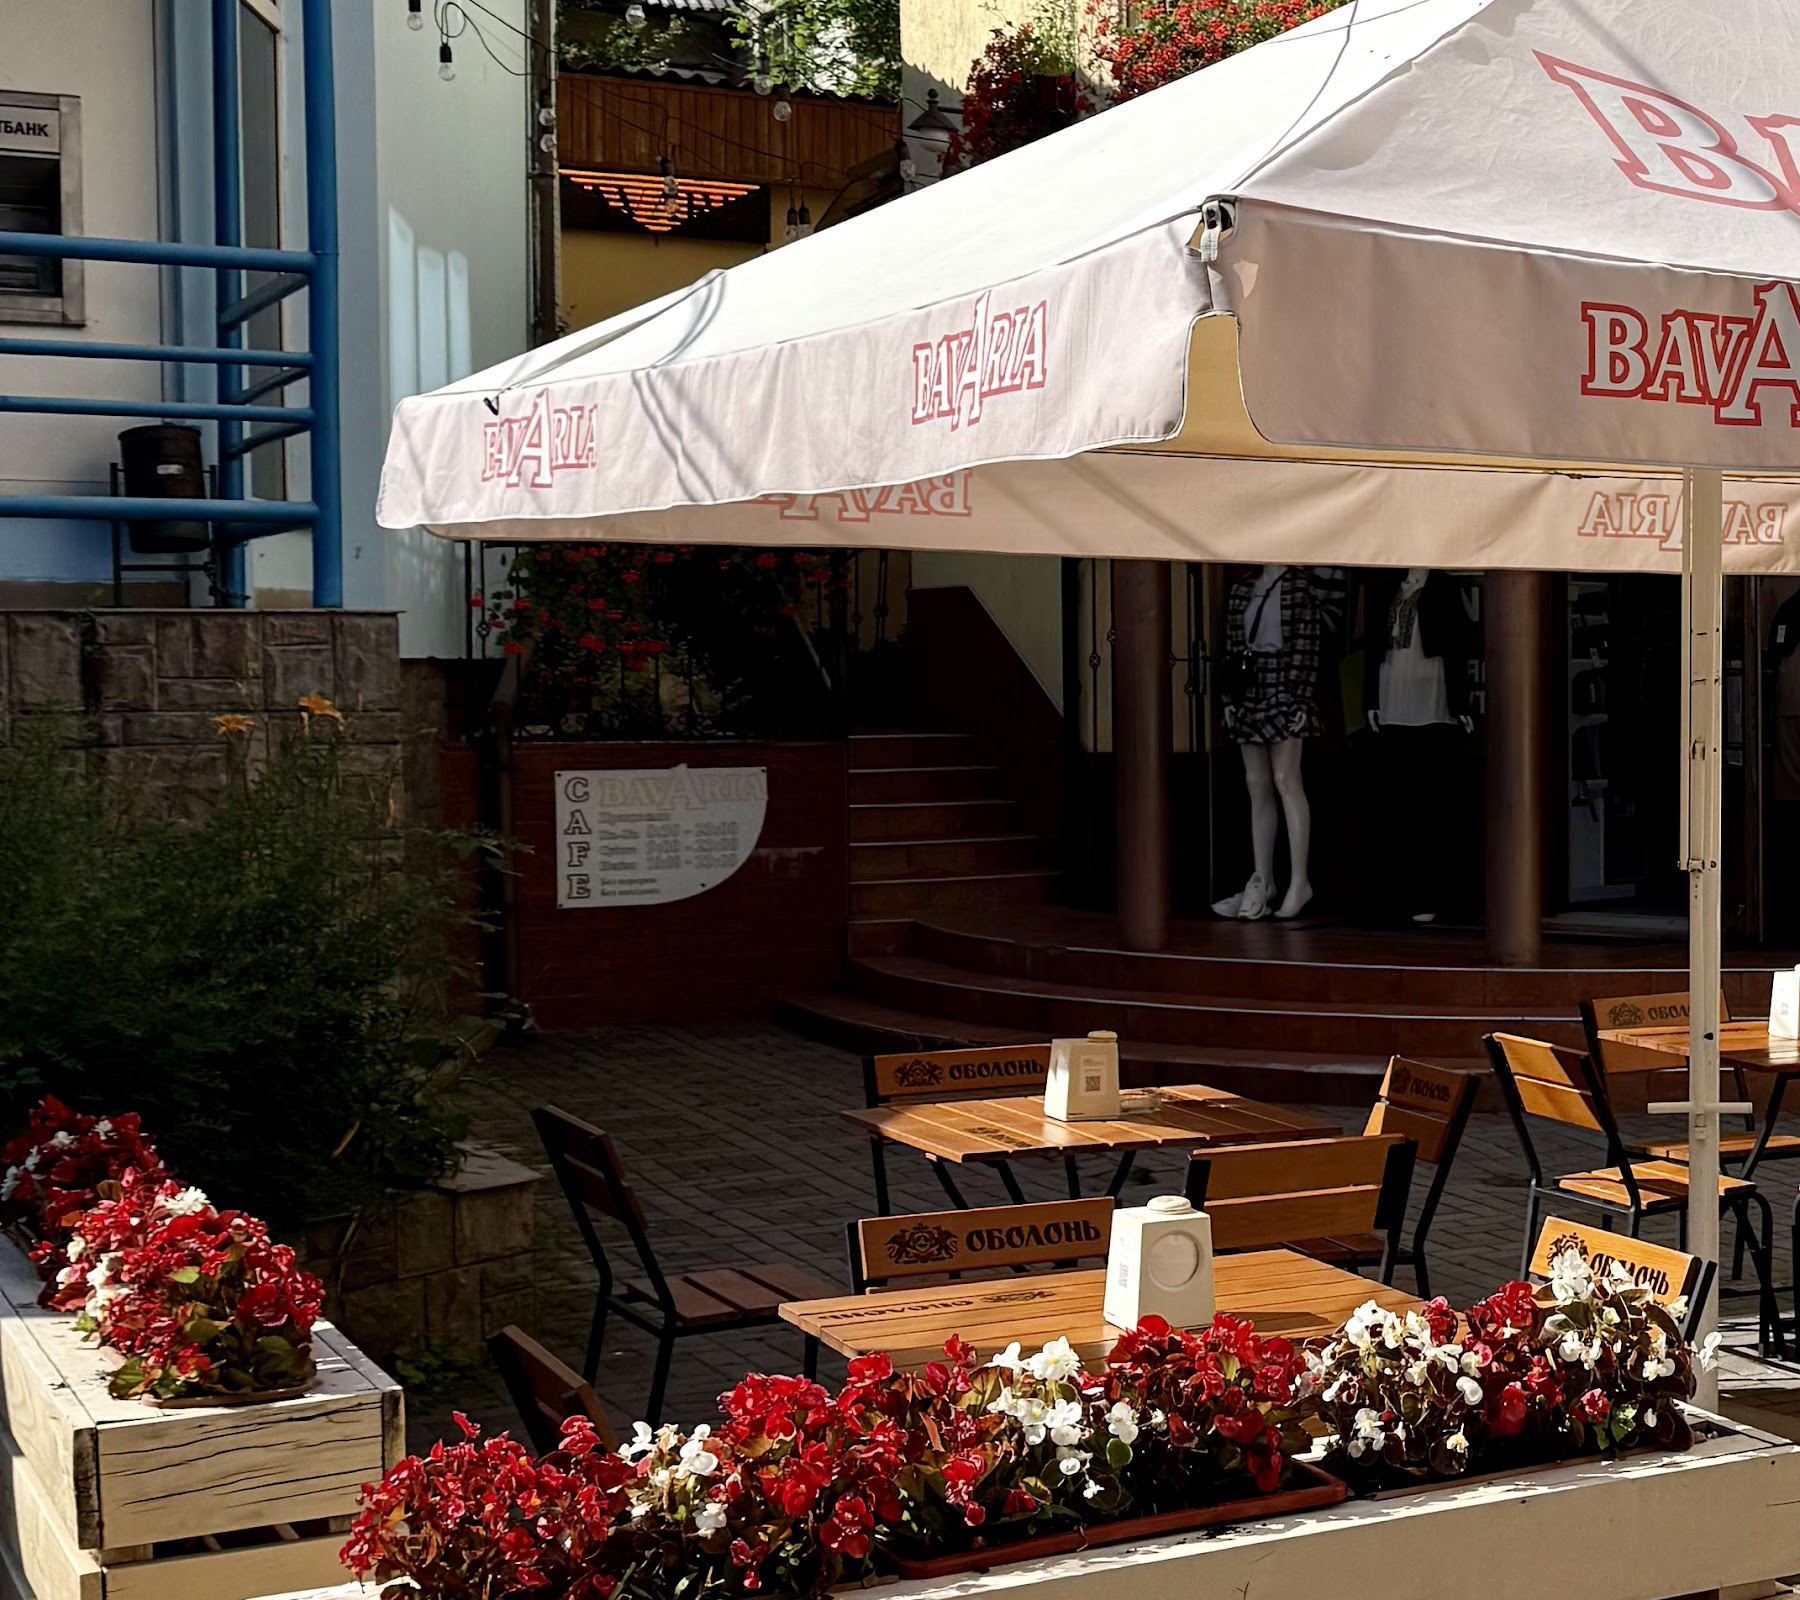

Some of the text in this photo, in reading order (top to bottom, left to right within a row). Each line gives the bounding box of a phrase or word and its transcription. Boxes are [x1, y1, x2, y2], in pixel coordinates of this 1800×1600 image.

[911, 289, 1048, 433] BAVARIA
[598, 763, 768, 811] BAVARIA
[563, 776, 592, 900] CAFE
[949, 1058, 1045, 1081] ОБОЛОНЬ
[965, 1220, 1100, 1253] ОБОЛОНЬ
